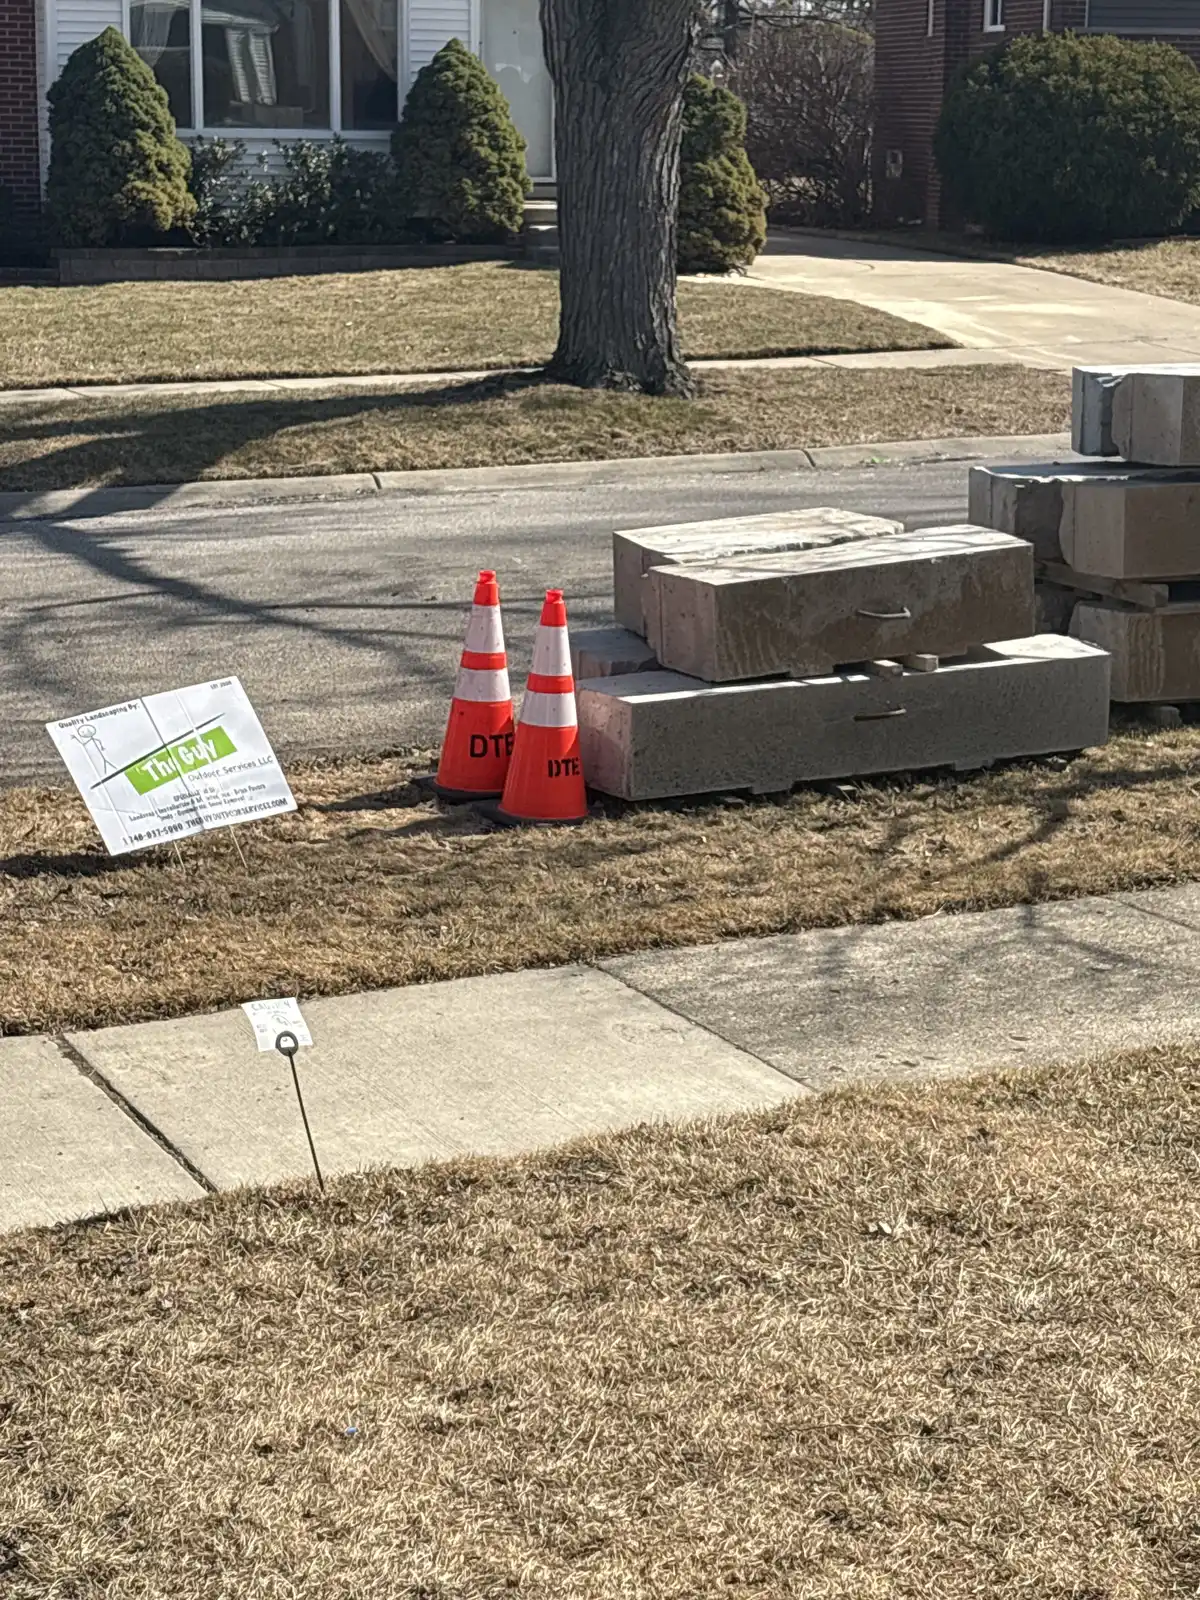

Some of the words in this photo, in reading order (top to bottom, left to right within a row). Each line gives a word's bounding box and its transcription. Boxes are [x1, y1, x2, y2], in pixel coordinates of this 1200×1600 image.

[58, 718, 84, 728] Quality
[84, 707, 128, 721] Landscaping
[177, 738, 216, 766] Guy
[470, 732, 515, 758] DTE
[188, 769, 220, 782] Outdoor
[222, 761, 256, 774] Services
[257, 755, 273, 765] LLC
[547, 757, 580, 778] DTE
